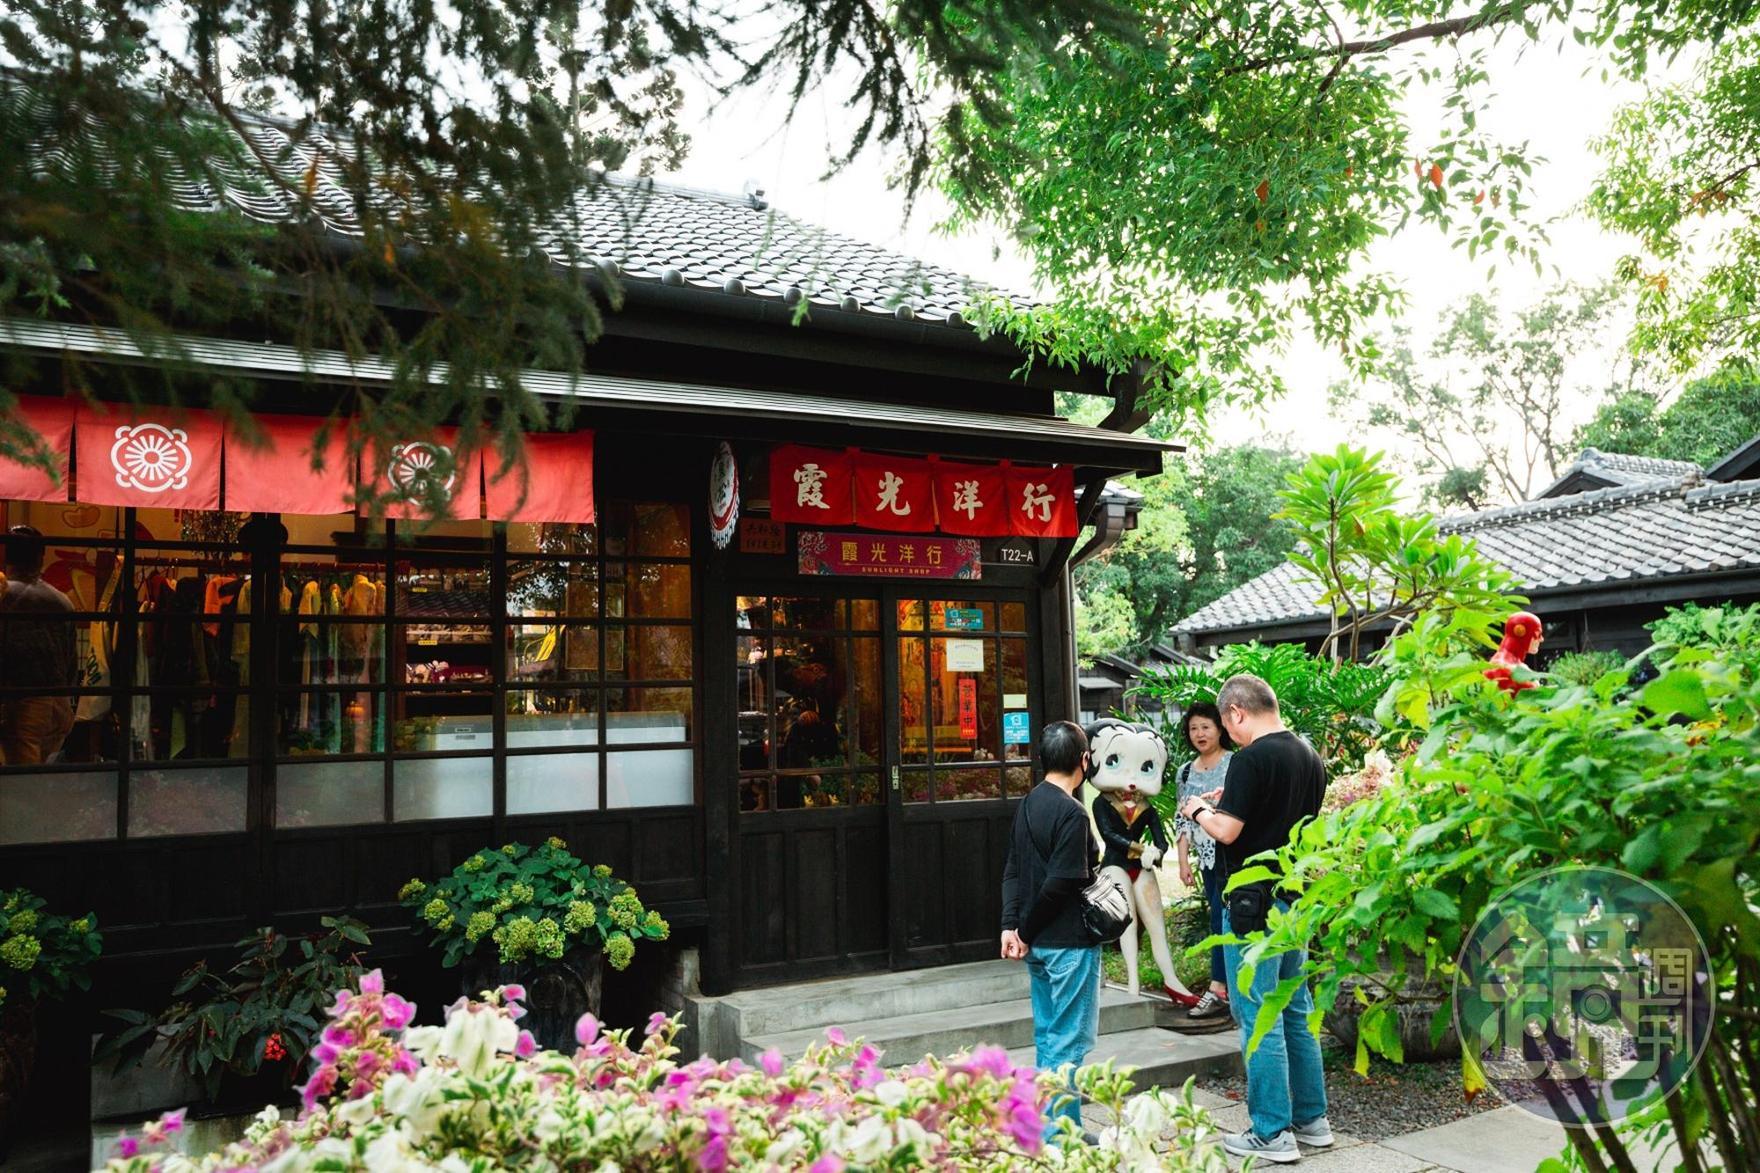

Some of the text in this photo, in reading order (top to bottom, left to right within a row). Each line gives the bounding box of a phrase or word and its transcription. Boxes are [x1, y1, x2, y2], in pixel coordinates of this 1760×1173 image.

[793, 463, 1056, 523] 霞光洋行
[841, 541, 943, 565] 霞光洋行
[1001, 548, 1034, 563] T22-A
[861, 566, 905, 574] SUNLIGHT
